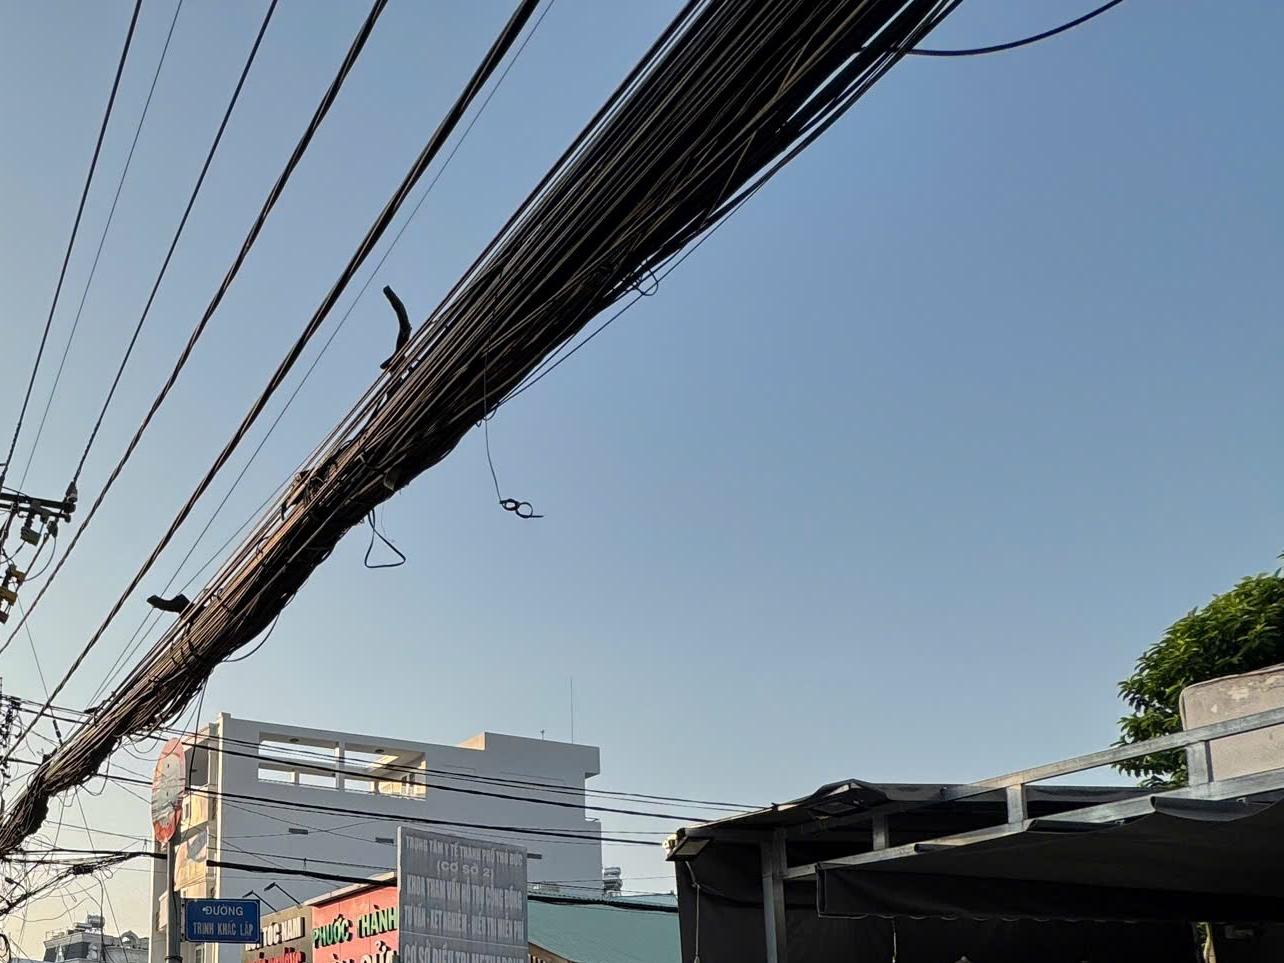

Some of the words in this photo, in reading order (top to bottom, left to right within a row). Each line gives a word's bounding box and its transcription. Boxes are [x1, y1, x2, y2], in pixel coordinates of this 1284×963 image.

[205, 904, 244, 916] ĐƯỜNG
[262, 922, 280, 947] TÓC
[281, 916, 303, 941] NAM
[312, 915, 351, 948] PHƯỚC
[357, 905, 398, 938] THÀNH
